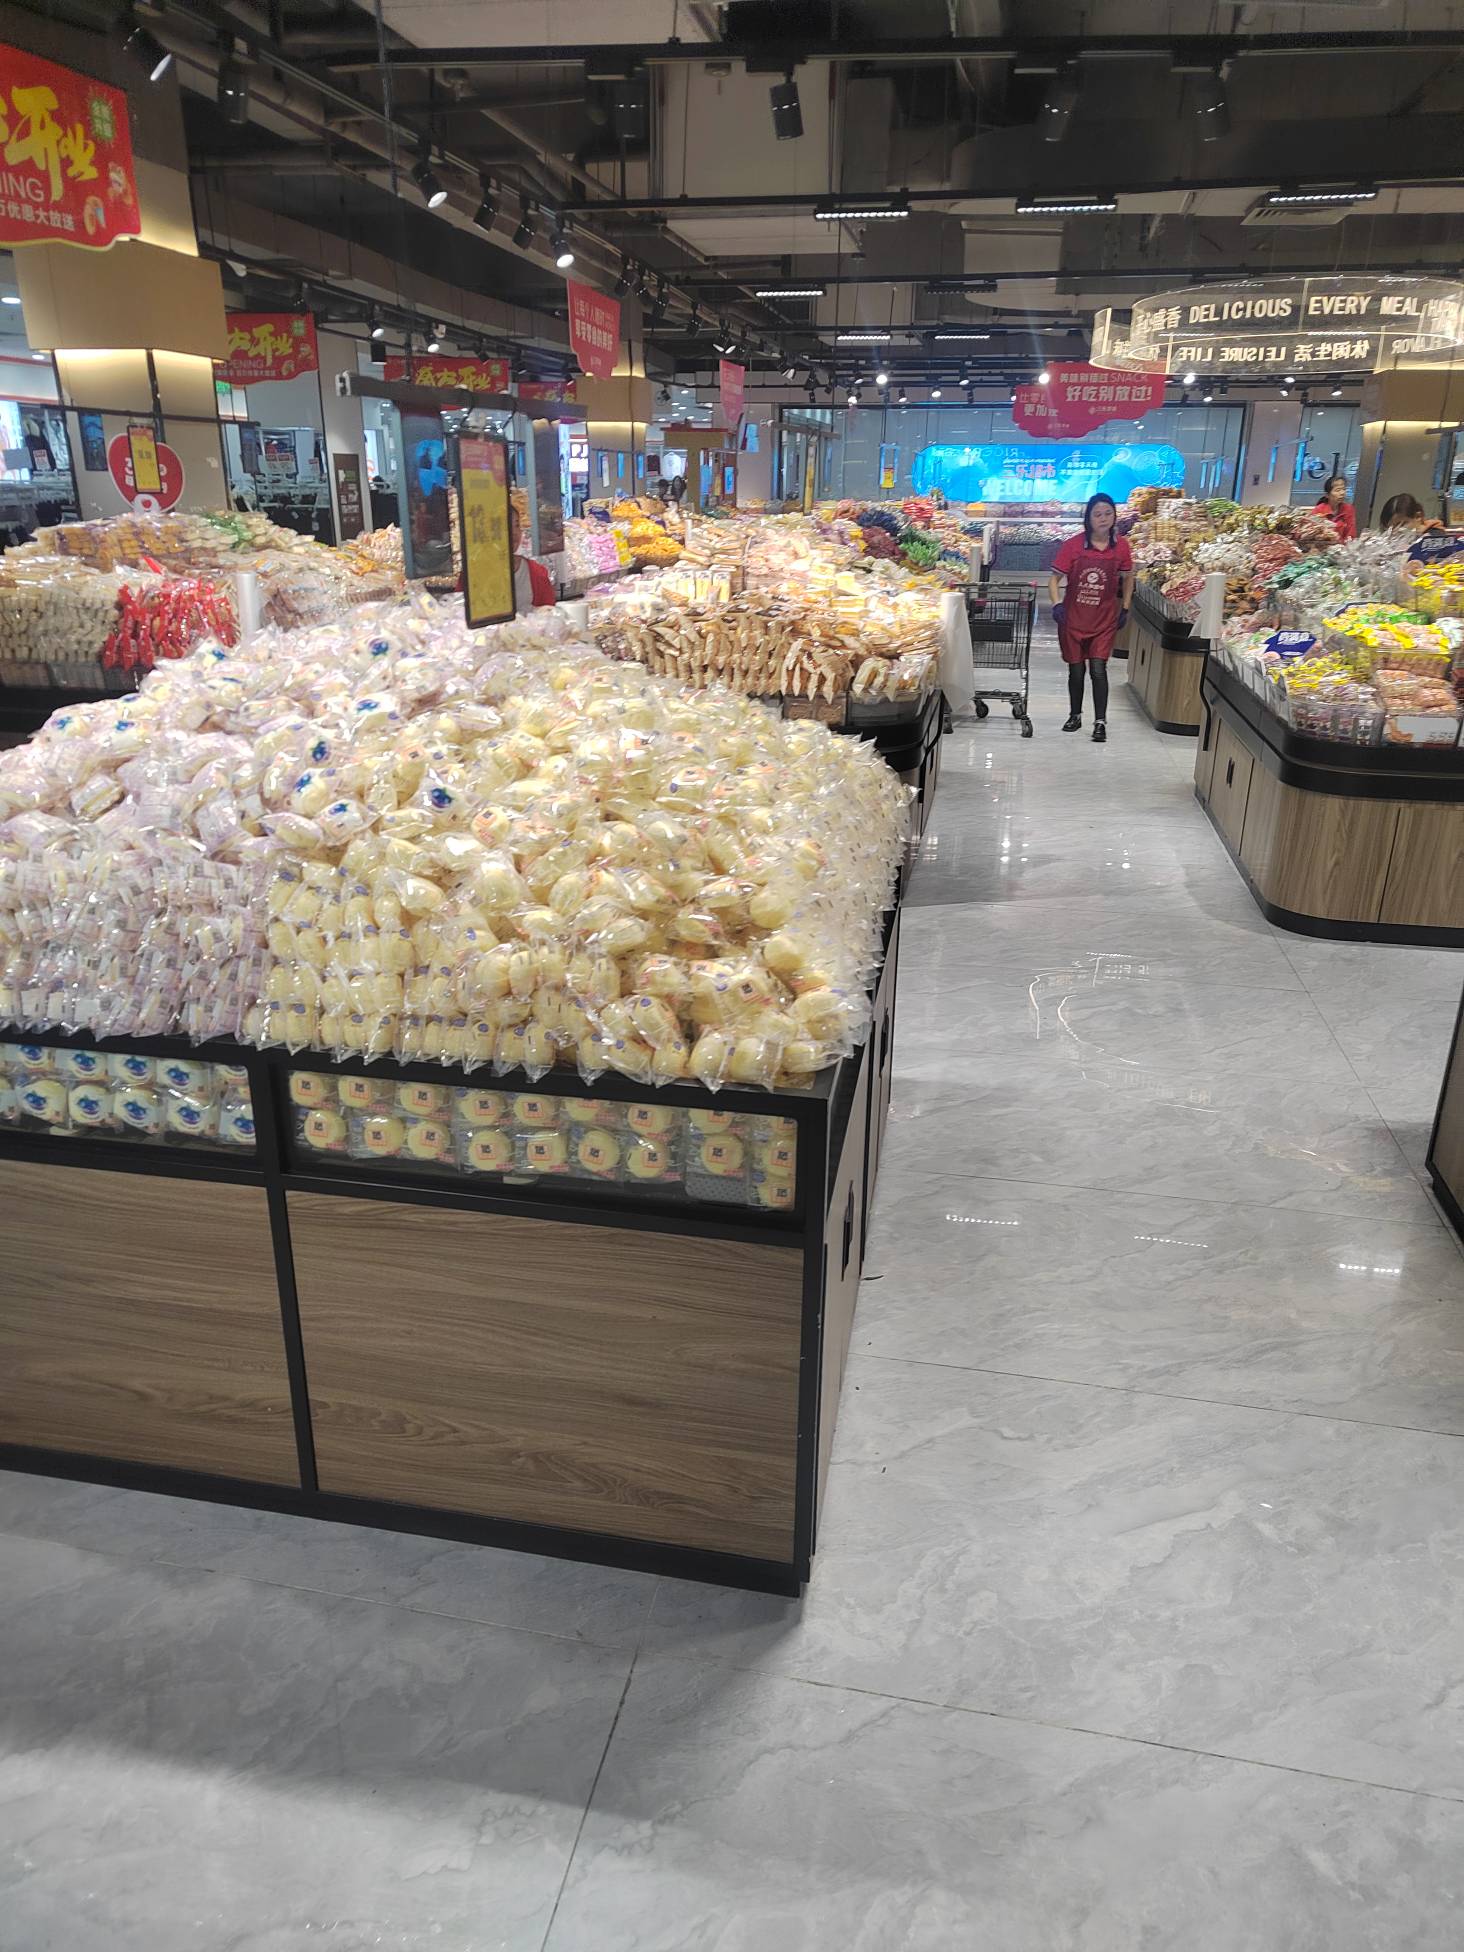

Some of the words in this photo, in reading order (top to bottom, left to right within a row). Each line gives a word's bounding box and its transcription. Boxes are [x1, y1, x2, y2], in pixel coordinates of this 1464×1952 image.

[0, 86, 99, 203] 开业
[0, 172, 45, 203] ING
[1189, 297, 1294, 324] DELICIOUS
[1308, 295, 1372, 315] EVERY
[1379, 296, 1421, 316] MEAL
[982, 479, 1058, 497] WELCOME
